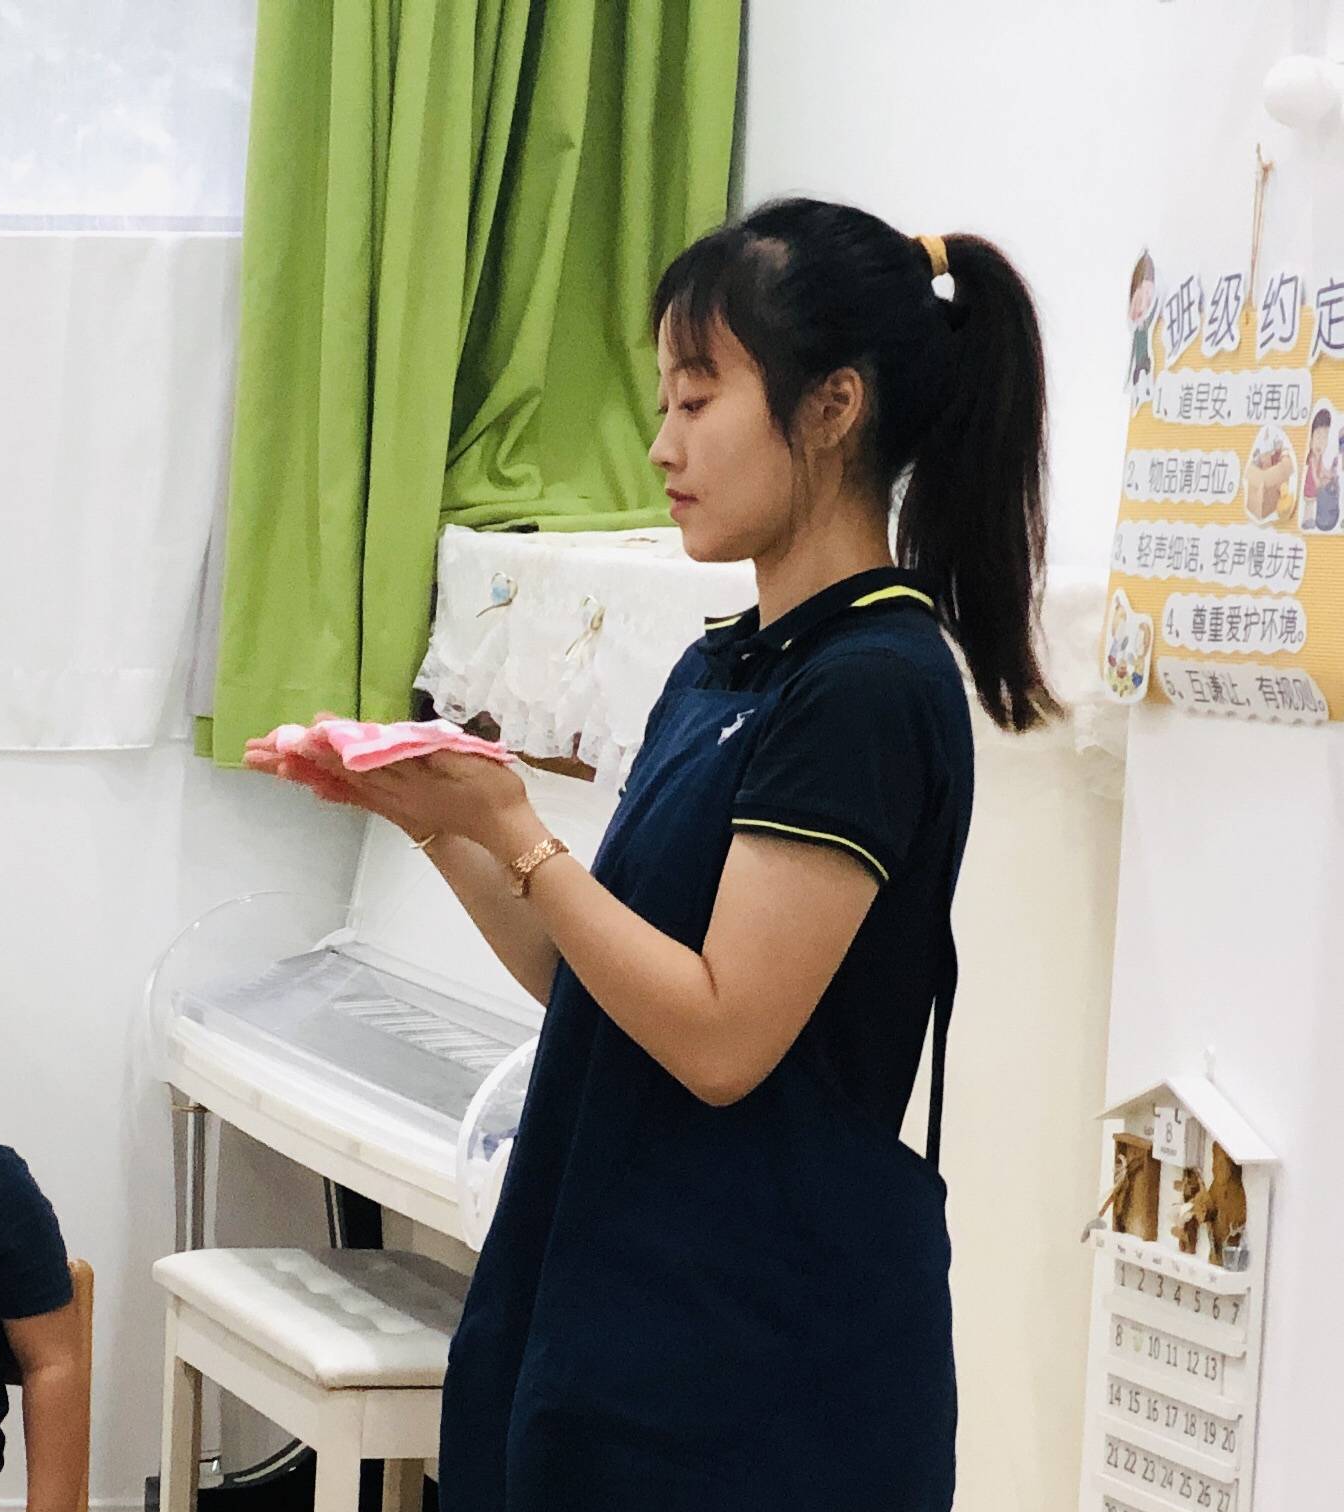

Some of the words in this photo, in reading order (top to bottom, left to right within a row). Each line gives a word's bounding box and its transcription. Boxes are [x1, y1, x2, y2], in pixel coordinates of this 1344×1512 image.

[1165, 272, 1344, 360] 班级约定
[1165, 1121, 1174, 1144] 8
[1148, 1335, 1160, 1359] 10
[1166, 1344, 1177, 1367] 11
[1187, 1349, 1199, 1375] 12
[1205, 1355, 1217, 1380] 13
[1109, 1383, 1121, 1405] 14
[1128, 1390, 1140, 1413] 15
[1146, 1399, 1158, 1422] 16
[1165, 1405, 1178, 1427] 17
[1184, 1412, 1196, 1436] 18
[1204, 1421, 1216, 1444] 19
[1222, 1426, 1235, 1452] 20
[1107, 1443, 1118, 1468] 21
[1124, 1448, 1136, 1474] 22
[1142, 1458, 1155, 1482] 23
[1160, 1466, 1173, 1490] 24
[1179, 1473, 1192, 1498] 25
[1197, 1480, 1211, 1507] 26
[1217, 1490, 1230, 1512] 27
